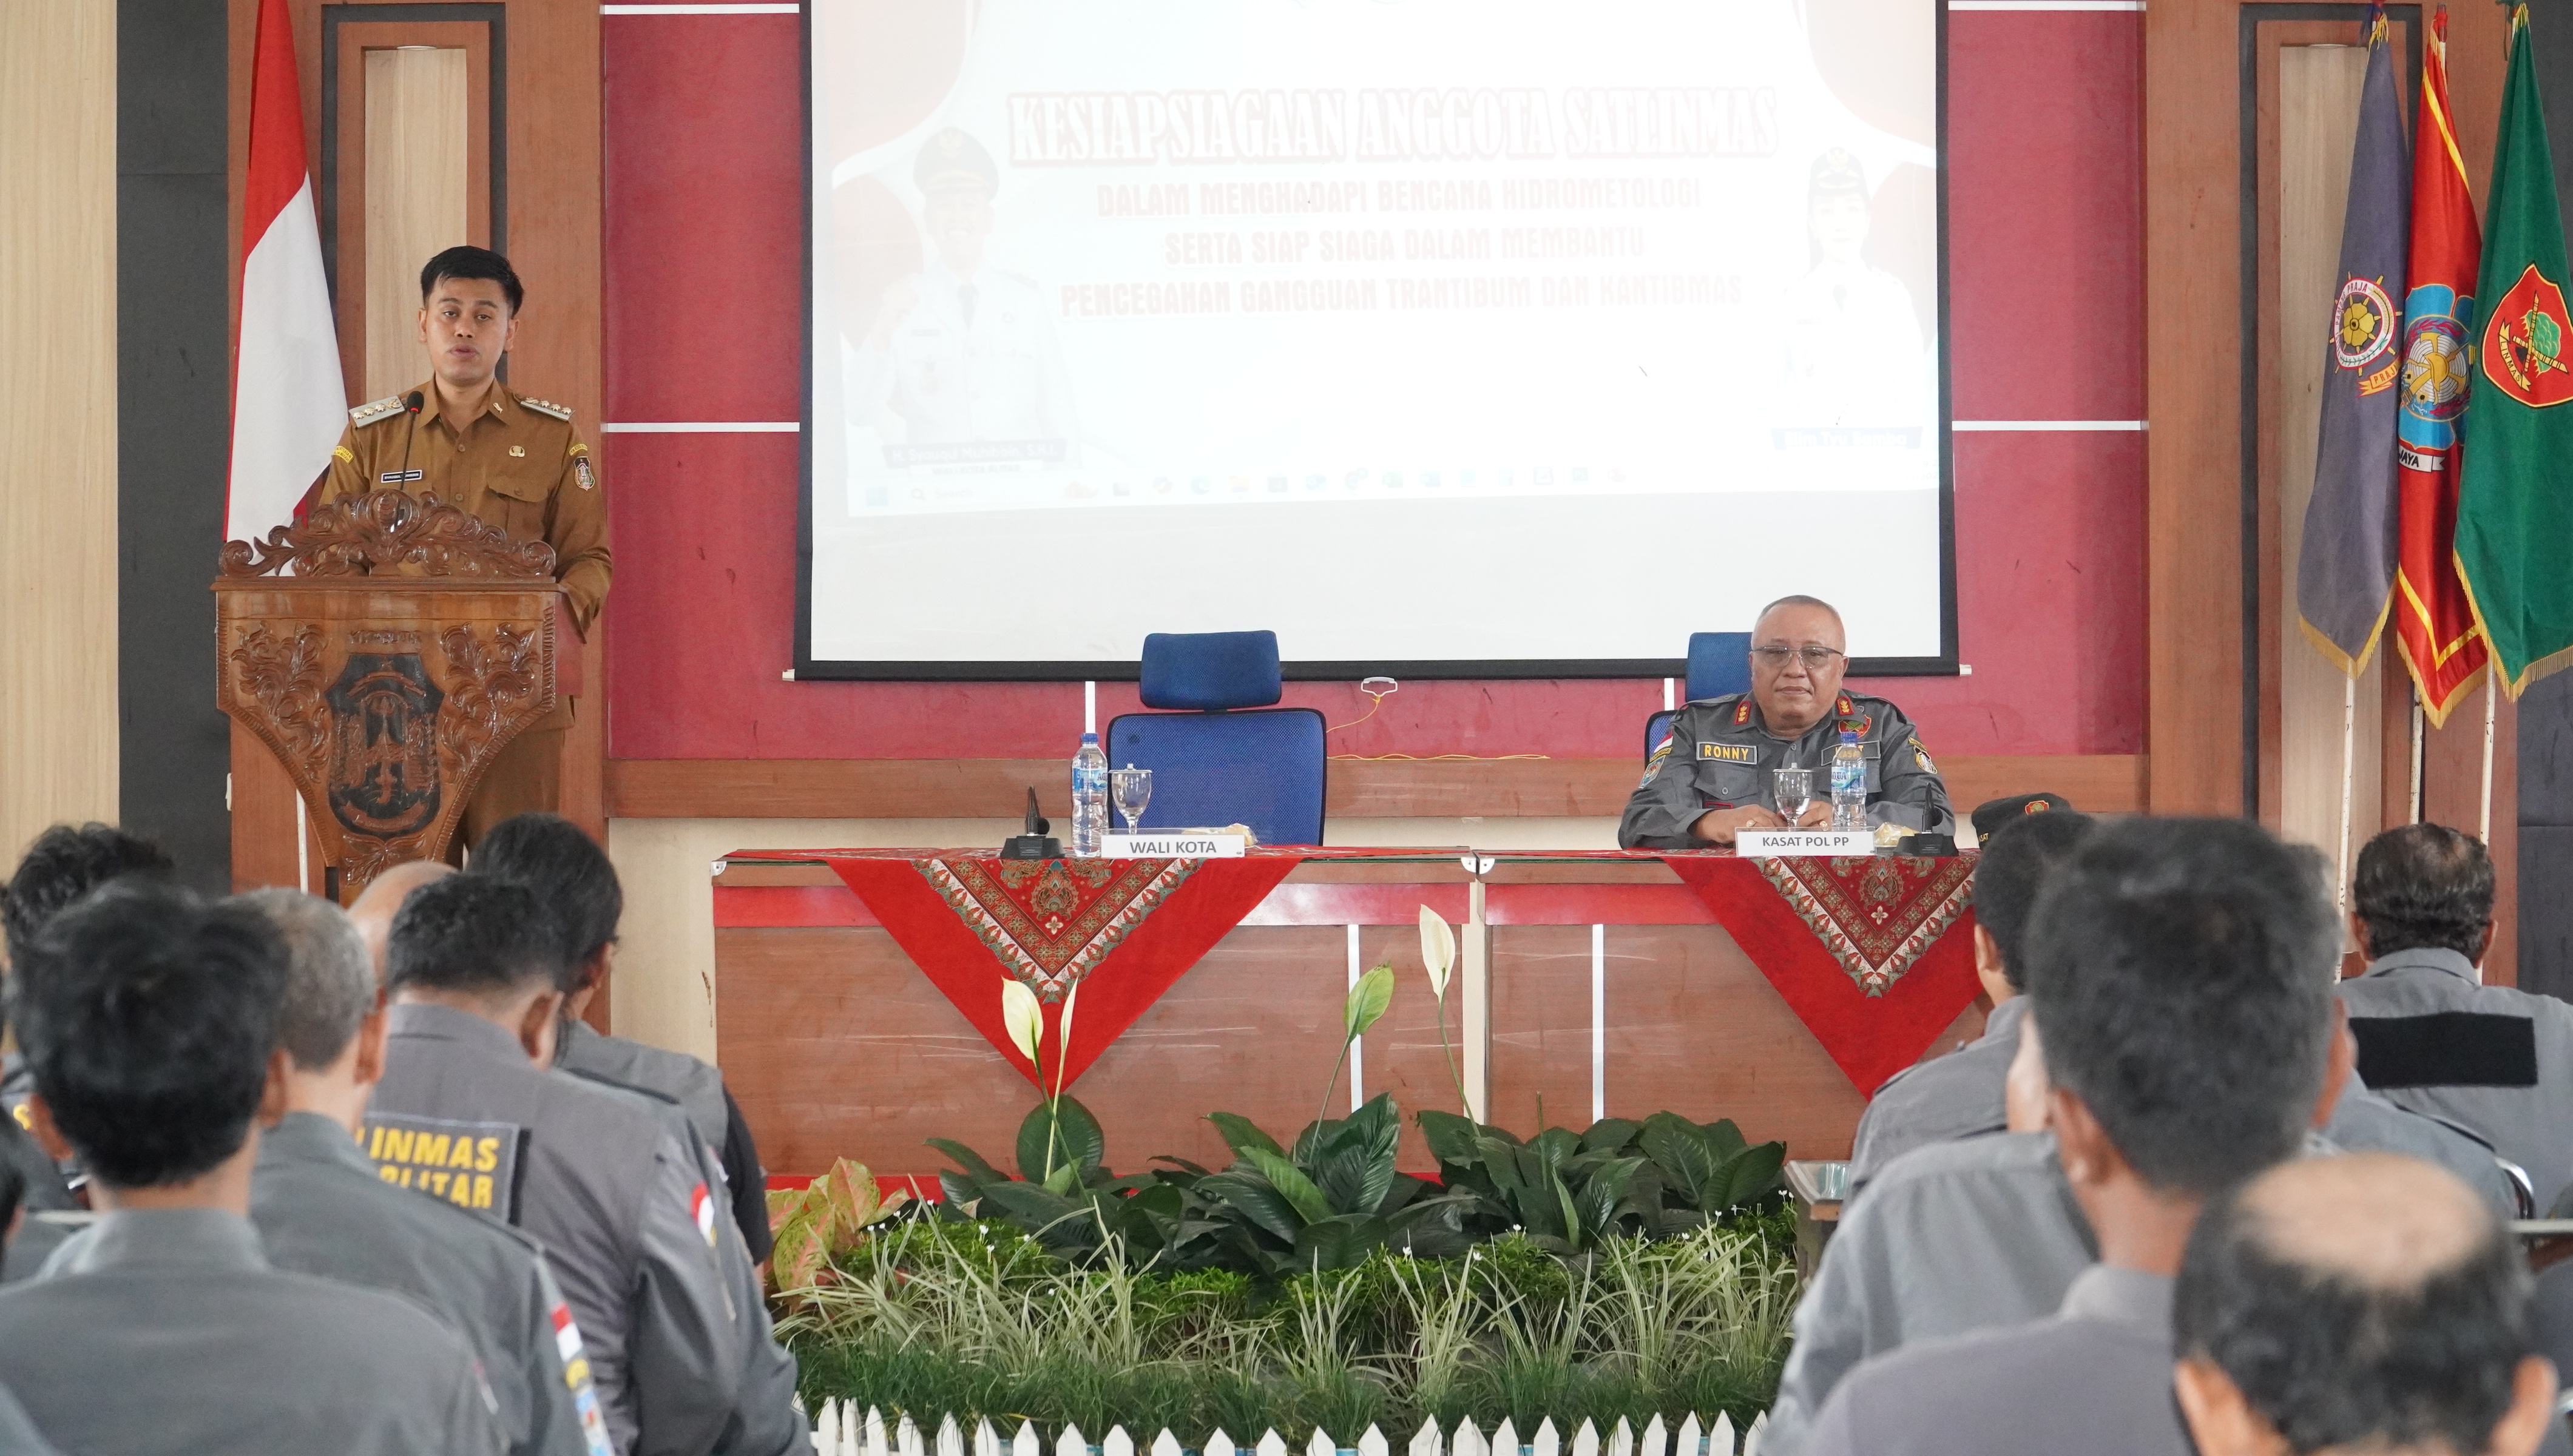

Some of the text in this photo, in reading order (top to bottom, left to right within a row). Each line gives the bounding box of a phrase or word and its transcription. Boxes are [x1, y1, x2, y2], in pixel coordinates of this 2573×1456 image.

[1009, 86, 1778, 164] KESIAPSIAGAAN ANGGOTA SATLINMAS
[1097, 177, 1701, 217] DALAM MENGHADAPI BENCANA HIDROMETOLOGI
[1164, 225, 1645, 265] SERTA SIAP SIAGA DALAM MEMBANTU
[1060, 273, 1742, 318] PENCEGAHAN GANGGUAN TRANTIBUM DAN KANTIBMAS
[2347, 281, 2368, 294] PRAJA
[2500, 340, 2522, 382] LINMAS
[1703, 744, 1748, 761] RONNY
[1833, 772, 1847, 781] QUA
[1129, 841, 1217, 854] WALI KOTA
[1762, 837, 1849, 846] KASAT POL PP
[356, 1125, 500, 1172] INMAS
